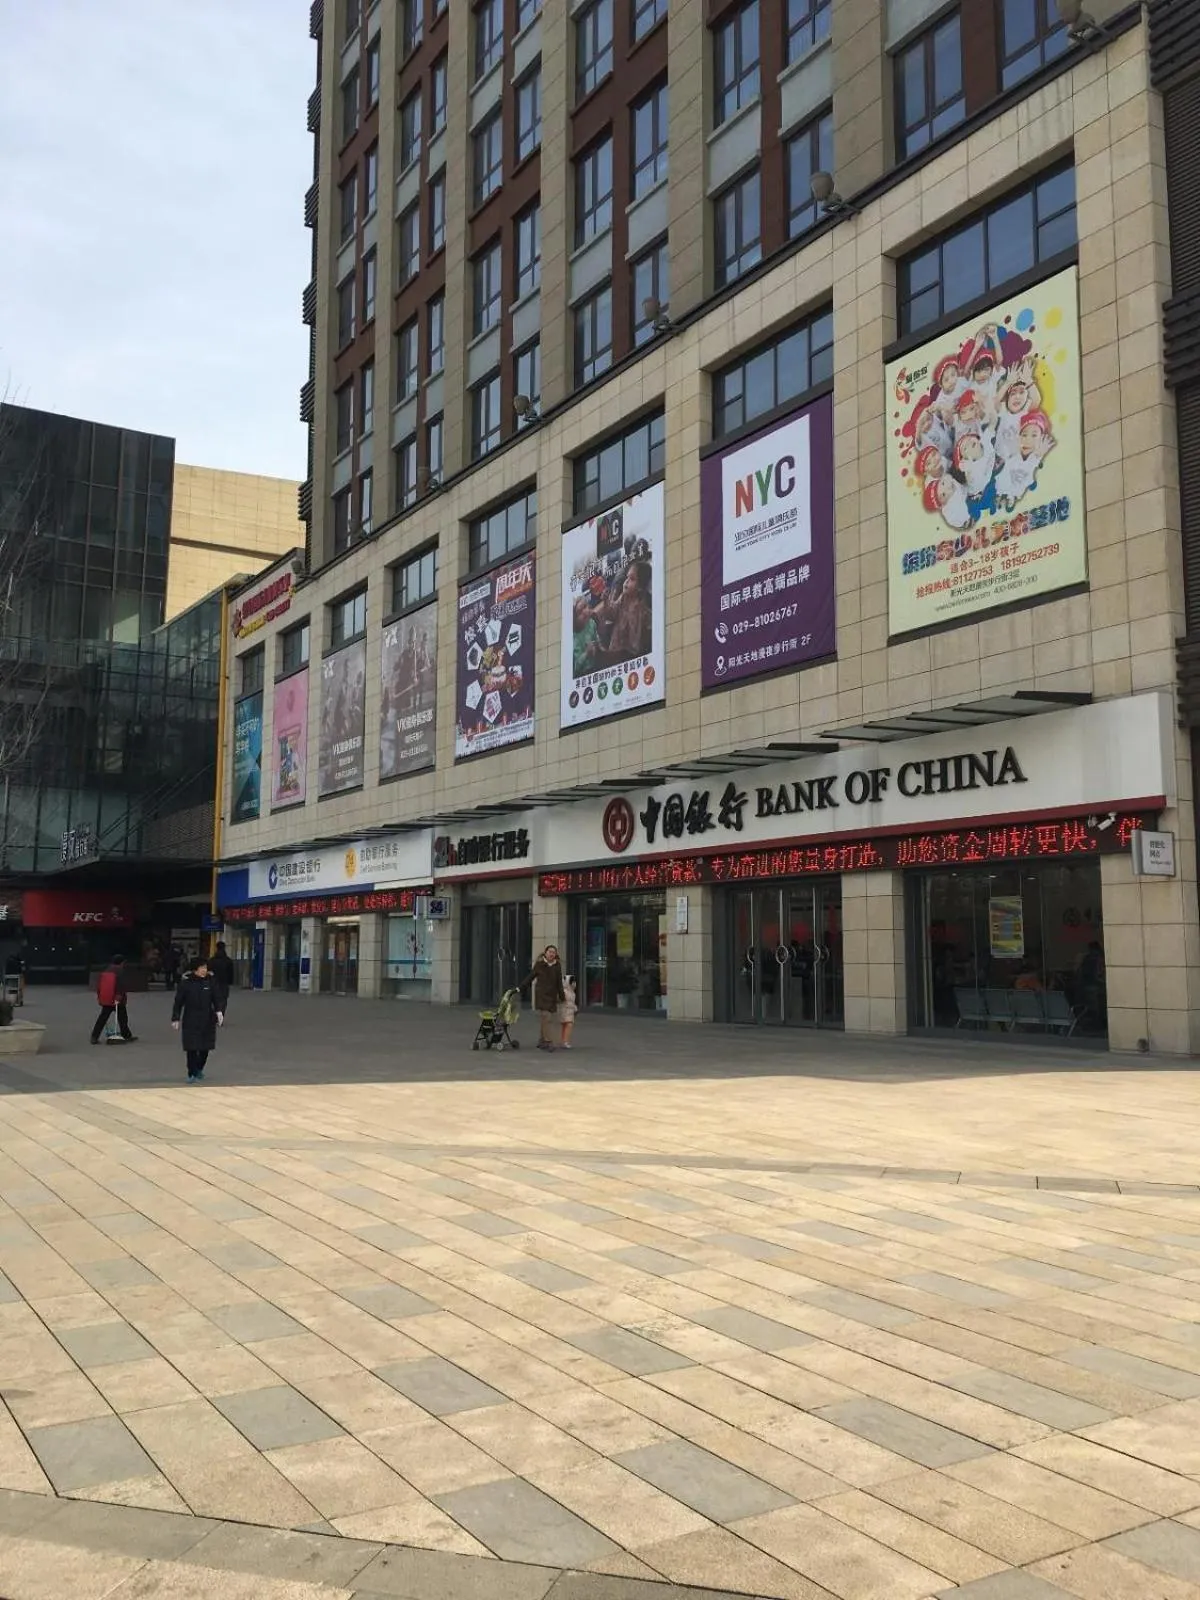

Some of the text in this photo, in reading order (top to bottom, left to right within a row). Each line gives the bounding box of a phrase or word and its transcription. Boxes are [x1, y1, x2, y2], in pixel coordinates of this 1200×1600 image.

[735, 455, 795, 518] NYC
[1001, 542, 1060, 571] 18192752739
[720, 564, 811, 611] 国际早教高端品牌
[732, 603, 798, 635] 029-81026767
[801, 633, 812, 646] 2F
[755, 746, 1028, 818] BANK OF CHINA
[458, 828, 530, 866] 自助银行服务
[279, 858, 321, 877] 中国建设银行
[72, 912, 103, 922] KFC
